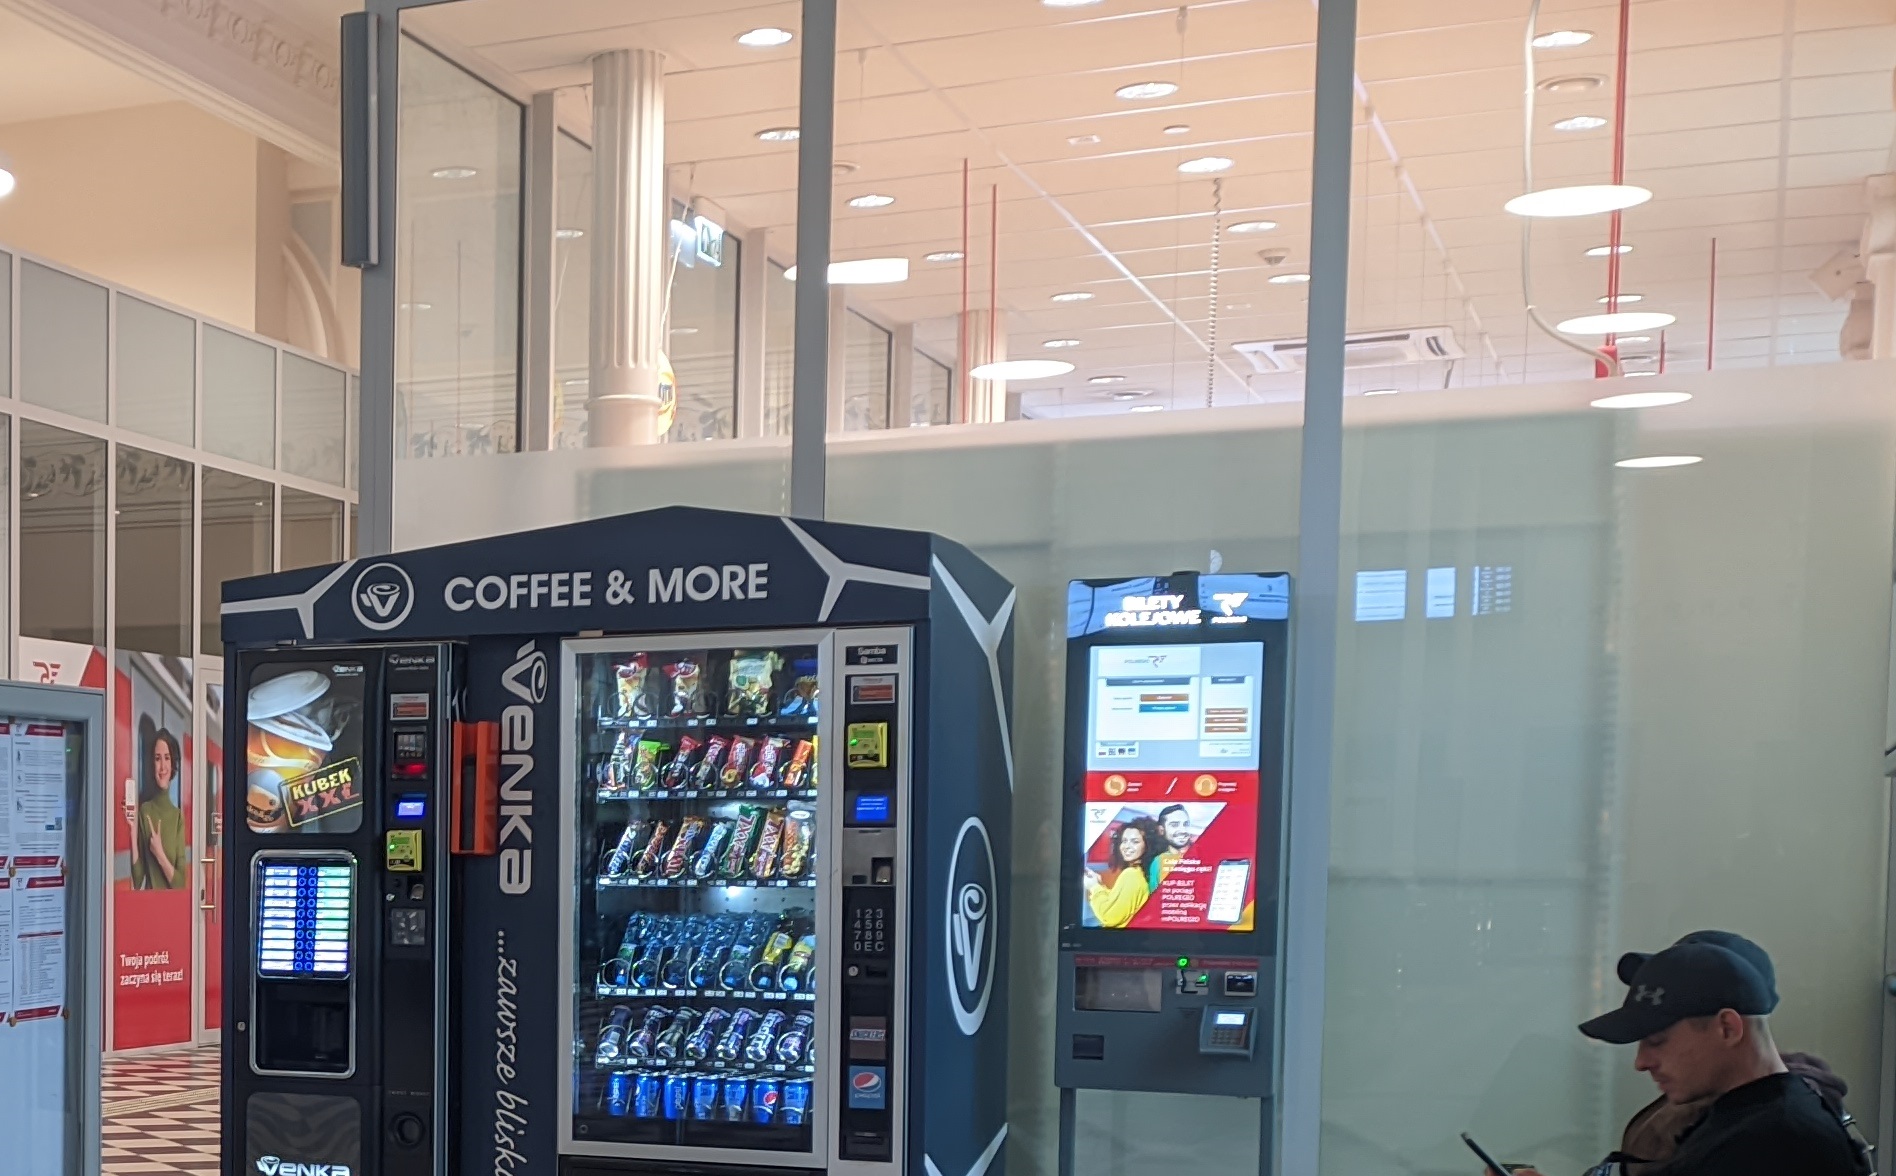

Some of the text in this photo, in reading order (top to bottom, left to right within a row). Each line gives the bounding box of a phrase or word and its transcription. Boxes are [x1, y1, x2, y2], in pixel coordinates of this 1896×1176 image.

[444, 563, 769, 612] COFFEE & MORE
[1122, 594, 1184, 611] BILETY
[1104, 609, 1202, 627] KOLEJOWE
[291, 768, 352, 800] KUBEK
[296, 784, 360, 816] XXL
[855, 909, 884, 919] 1 2 3
[854, 920, 884, 930] 4 5 6
[854, 931, 884, 941] 7 8 9
[854, 941, 884, 951] 0 E C
[120, 952, 143, 969] Twoja
